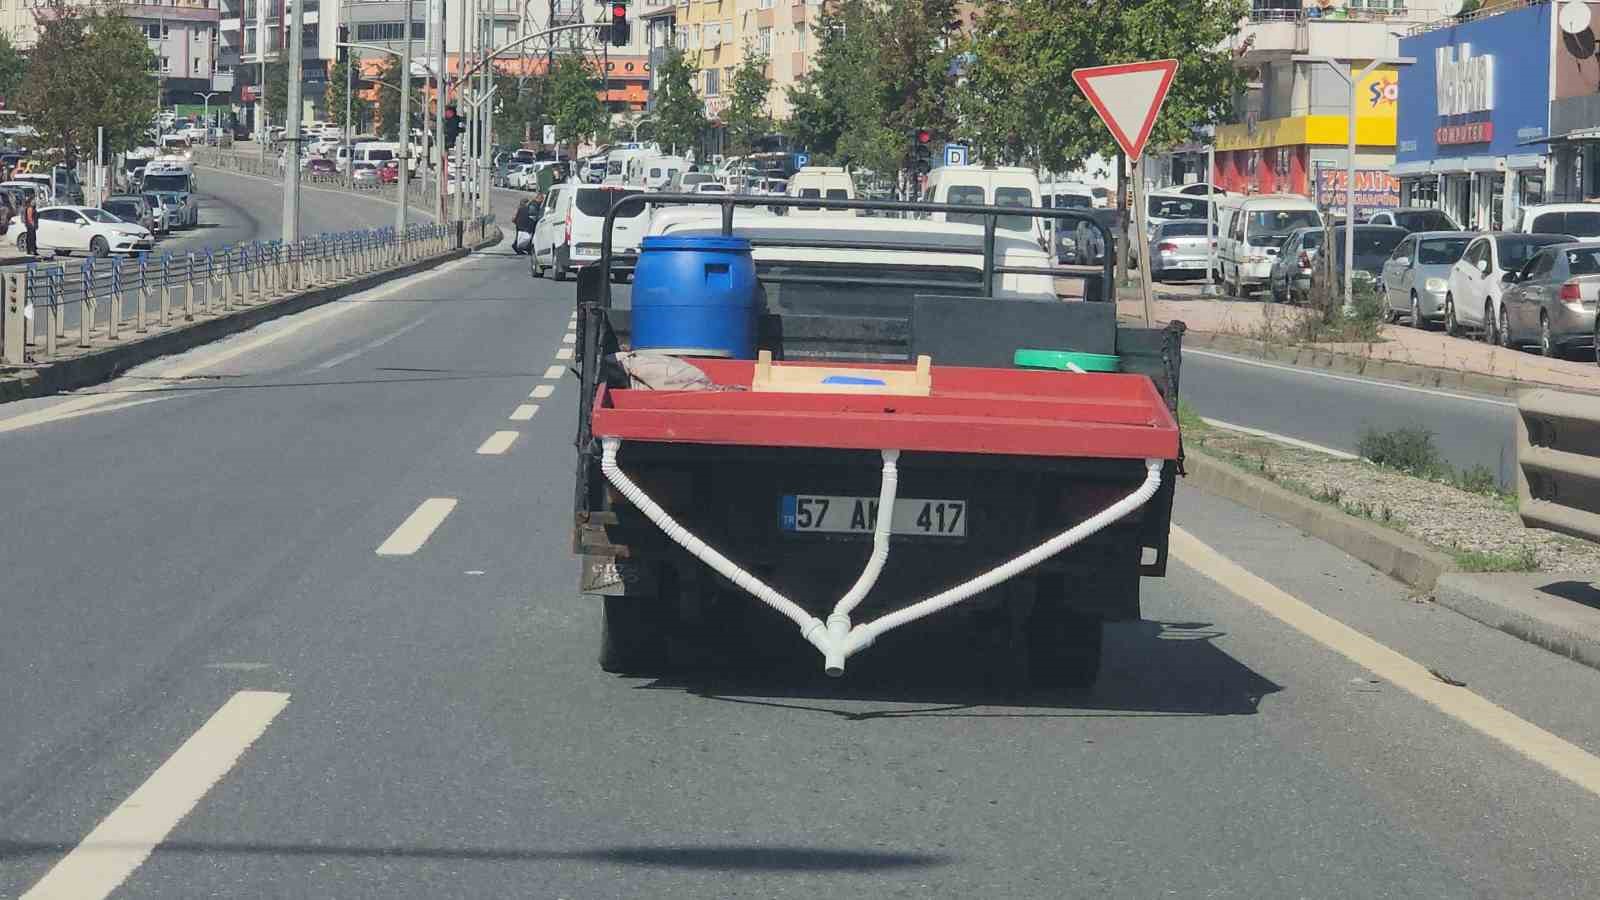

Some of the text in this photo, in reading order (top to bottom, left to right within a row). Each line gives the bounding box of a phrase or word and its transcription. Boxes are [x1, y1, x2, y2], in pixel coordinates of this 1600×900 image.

[951, 151, 961, 164] D
[797, 498, 830, 529] 57
[916, 502, 963, 533] 417
